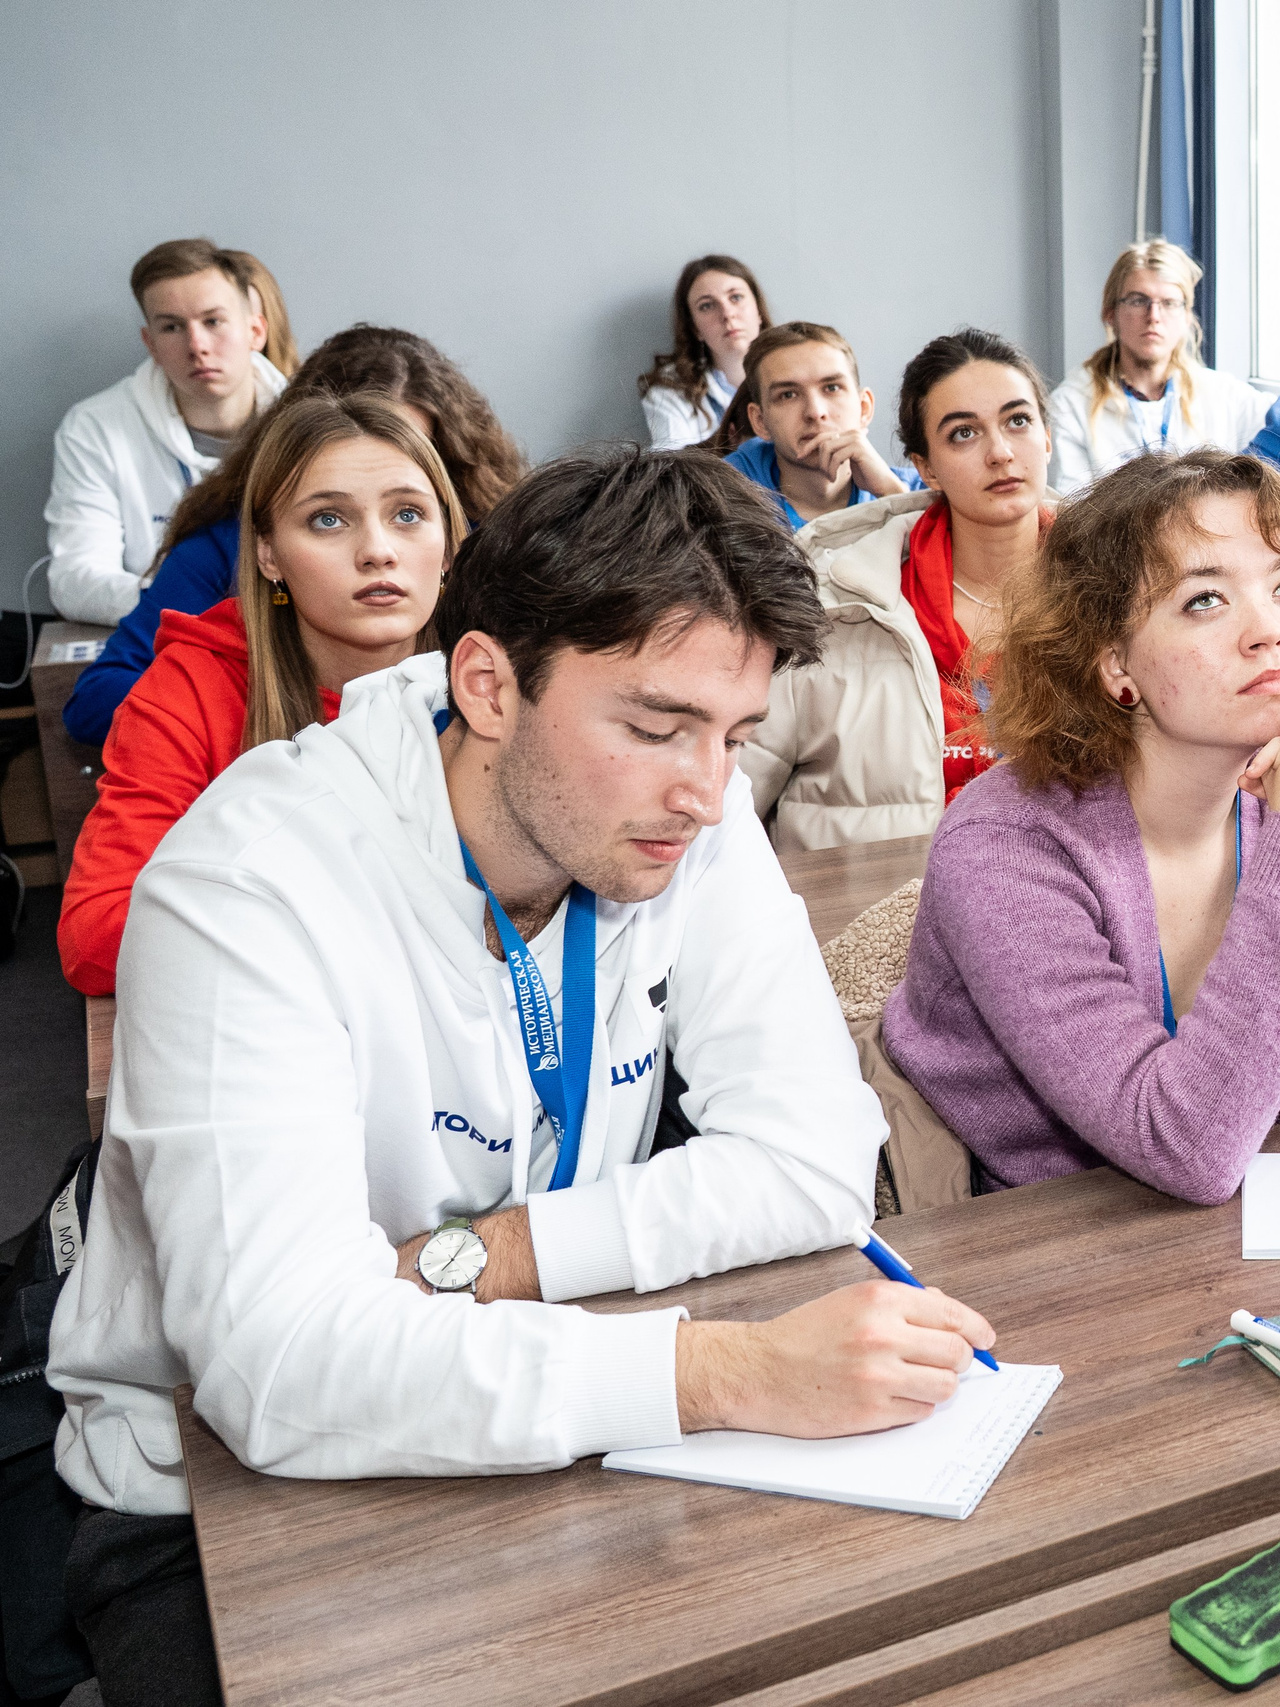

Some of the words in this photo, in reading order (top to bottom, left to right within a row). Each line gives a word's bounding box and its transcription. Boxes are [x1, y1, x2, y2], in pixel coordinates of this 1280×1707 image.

[510, 950, 541, 1056] ИСТОРИЧЕСКАЯ
[524, 953, 556, 1054] МЕДИАШКОЛА
[431, 1110, 513, 1154] ТОРИ
